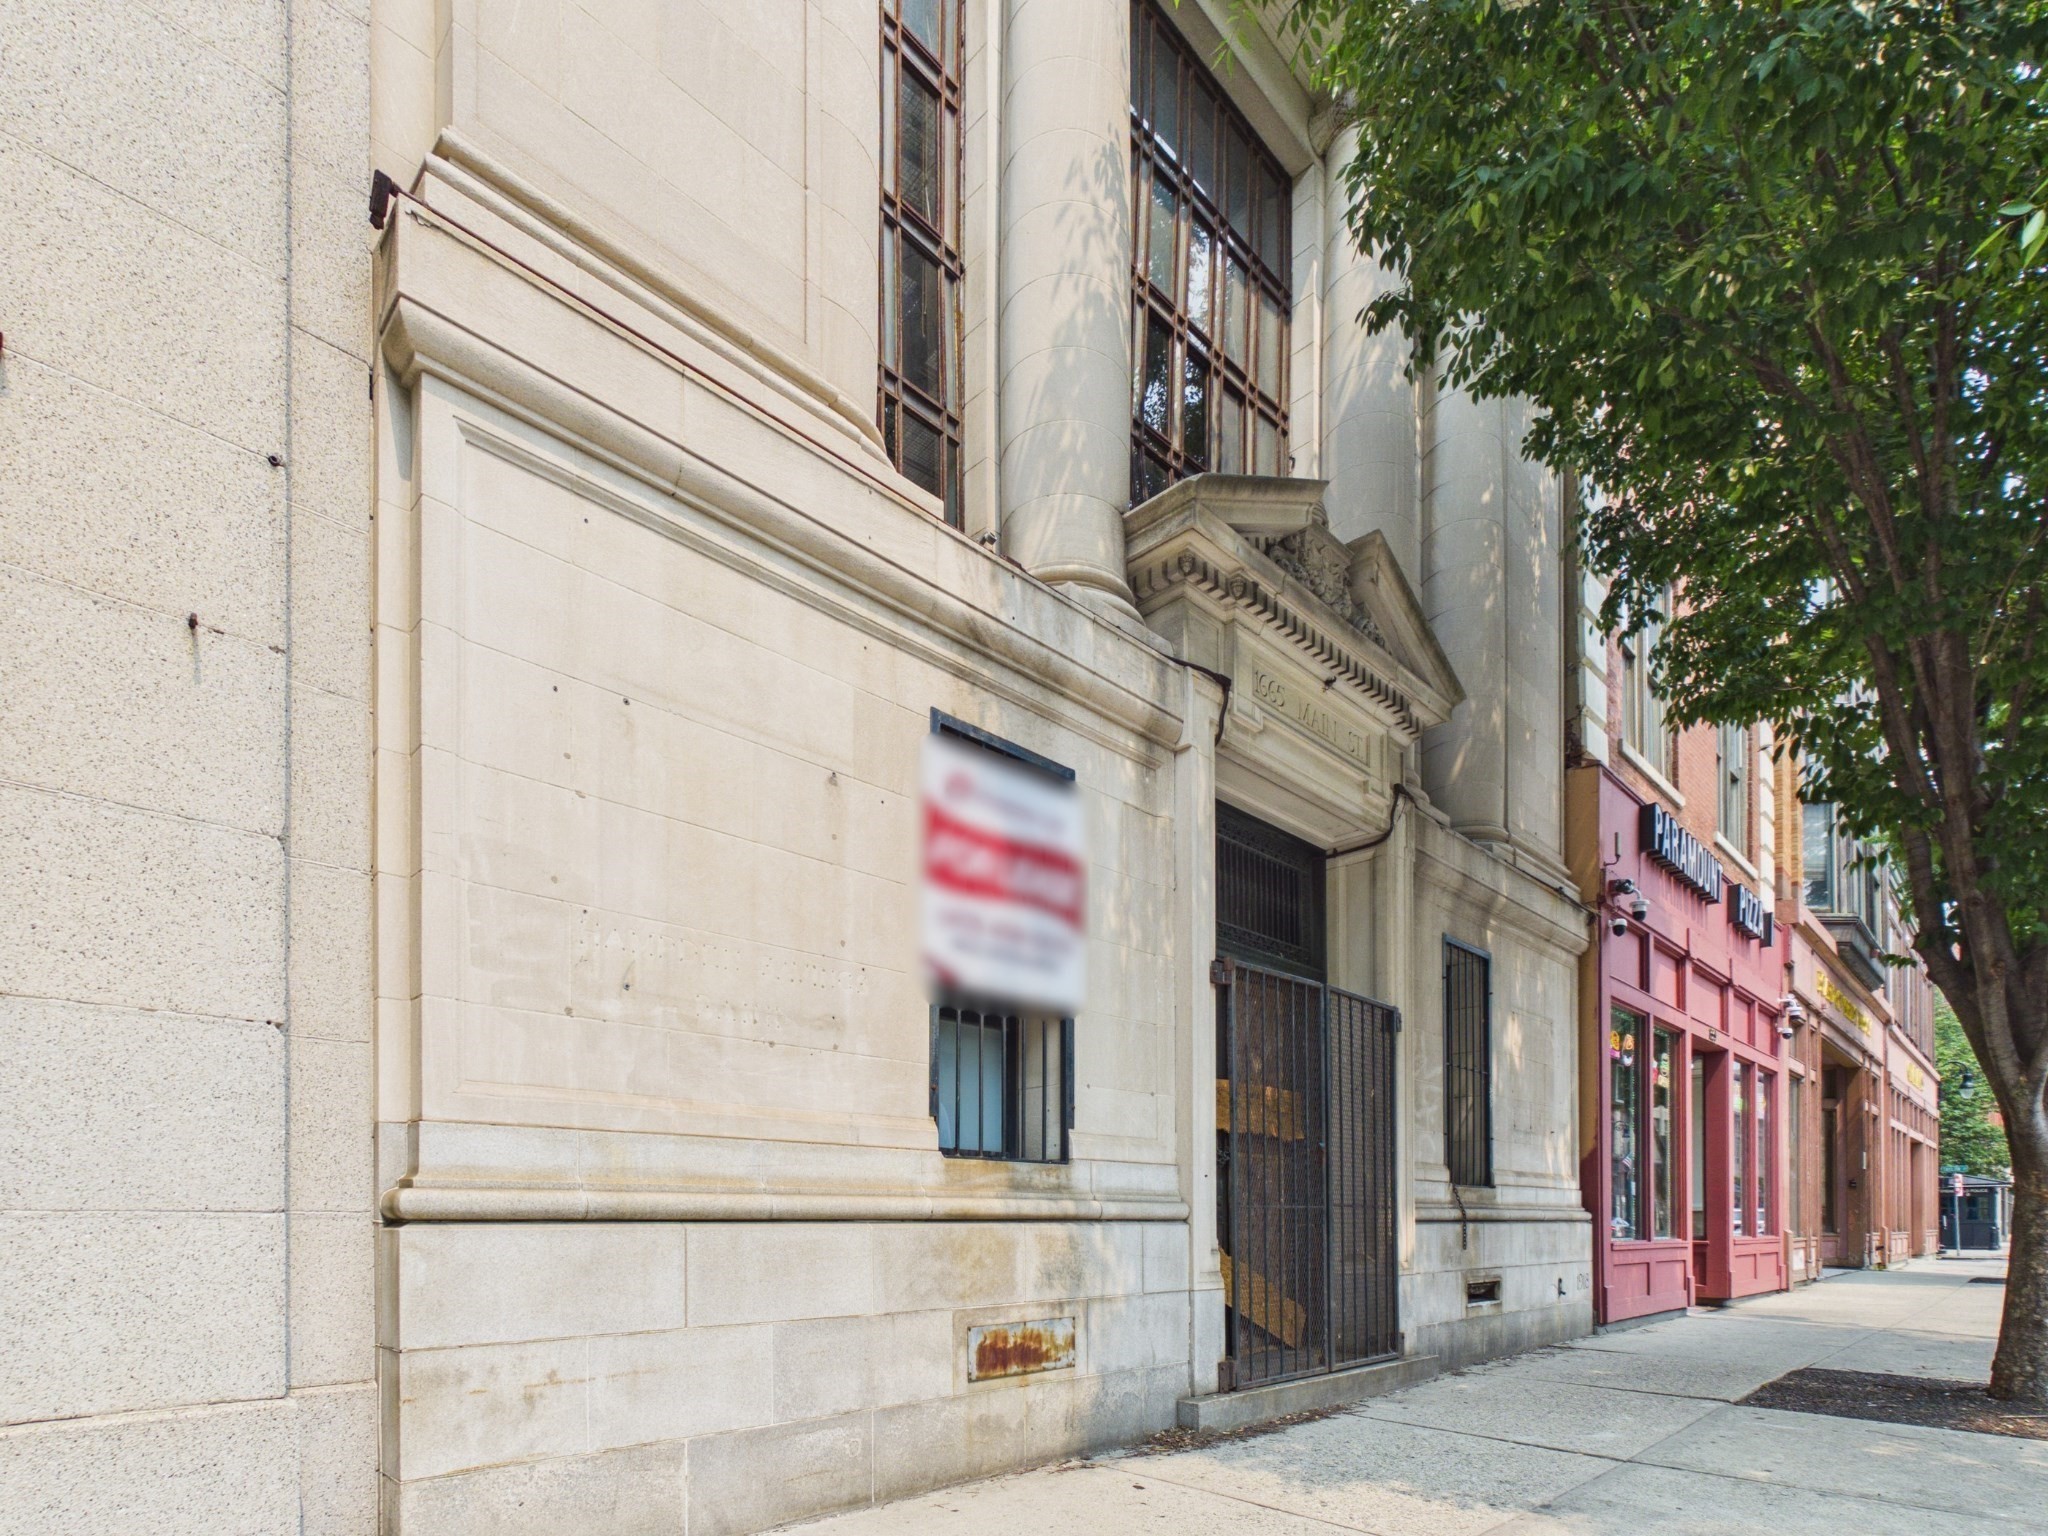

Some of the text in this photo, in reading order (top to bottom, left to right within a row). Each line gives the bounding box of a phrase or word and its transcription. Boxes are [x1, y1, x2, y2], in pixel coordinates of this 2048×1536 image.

[1255, 670, 1285, 707] 1665
[1298, 696, 1337, 743] MAIN
[1654, 803, 1765, 940] PARAMOUNT PIZZA
